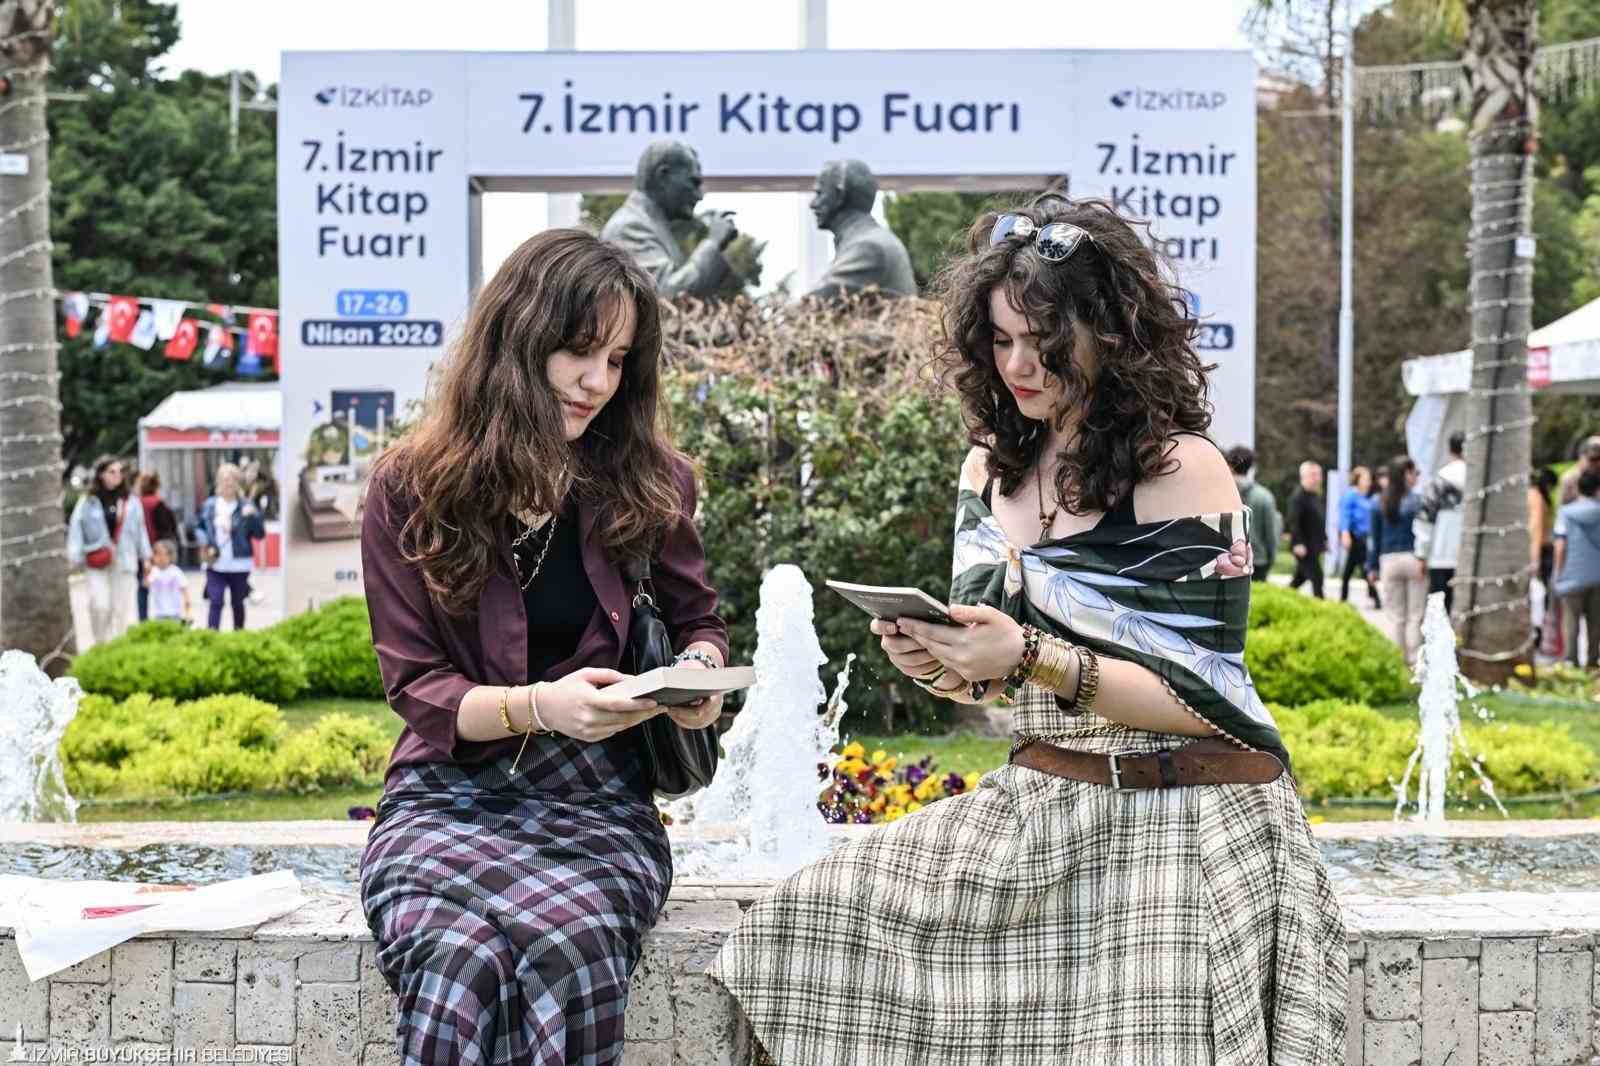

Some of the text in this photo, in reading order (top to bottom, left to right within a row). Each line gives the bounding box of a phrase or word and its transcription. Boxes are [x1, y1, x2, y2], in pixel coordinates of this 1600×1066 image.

[719, 92, 862, 143] Kitap
[883, 92, 1019, 133] Fuarı
[317, 183, 428, 222] Kitap
[1112, 186, 1221, 226] Kitap
[318, 226, 426, 257] Fuarı
[1156, 238, 1217, 259] arı
[342, 293, 403, 315] 17-26
[306, 323, 438, 345] Nisan 2026
[1199, 325, 1229, 348] 26
